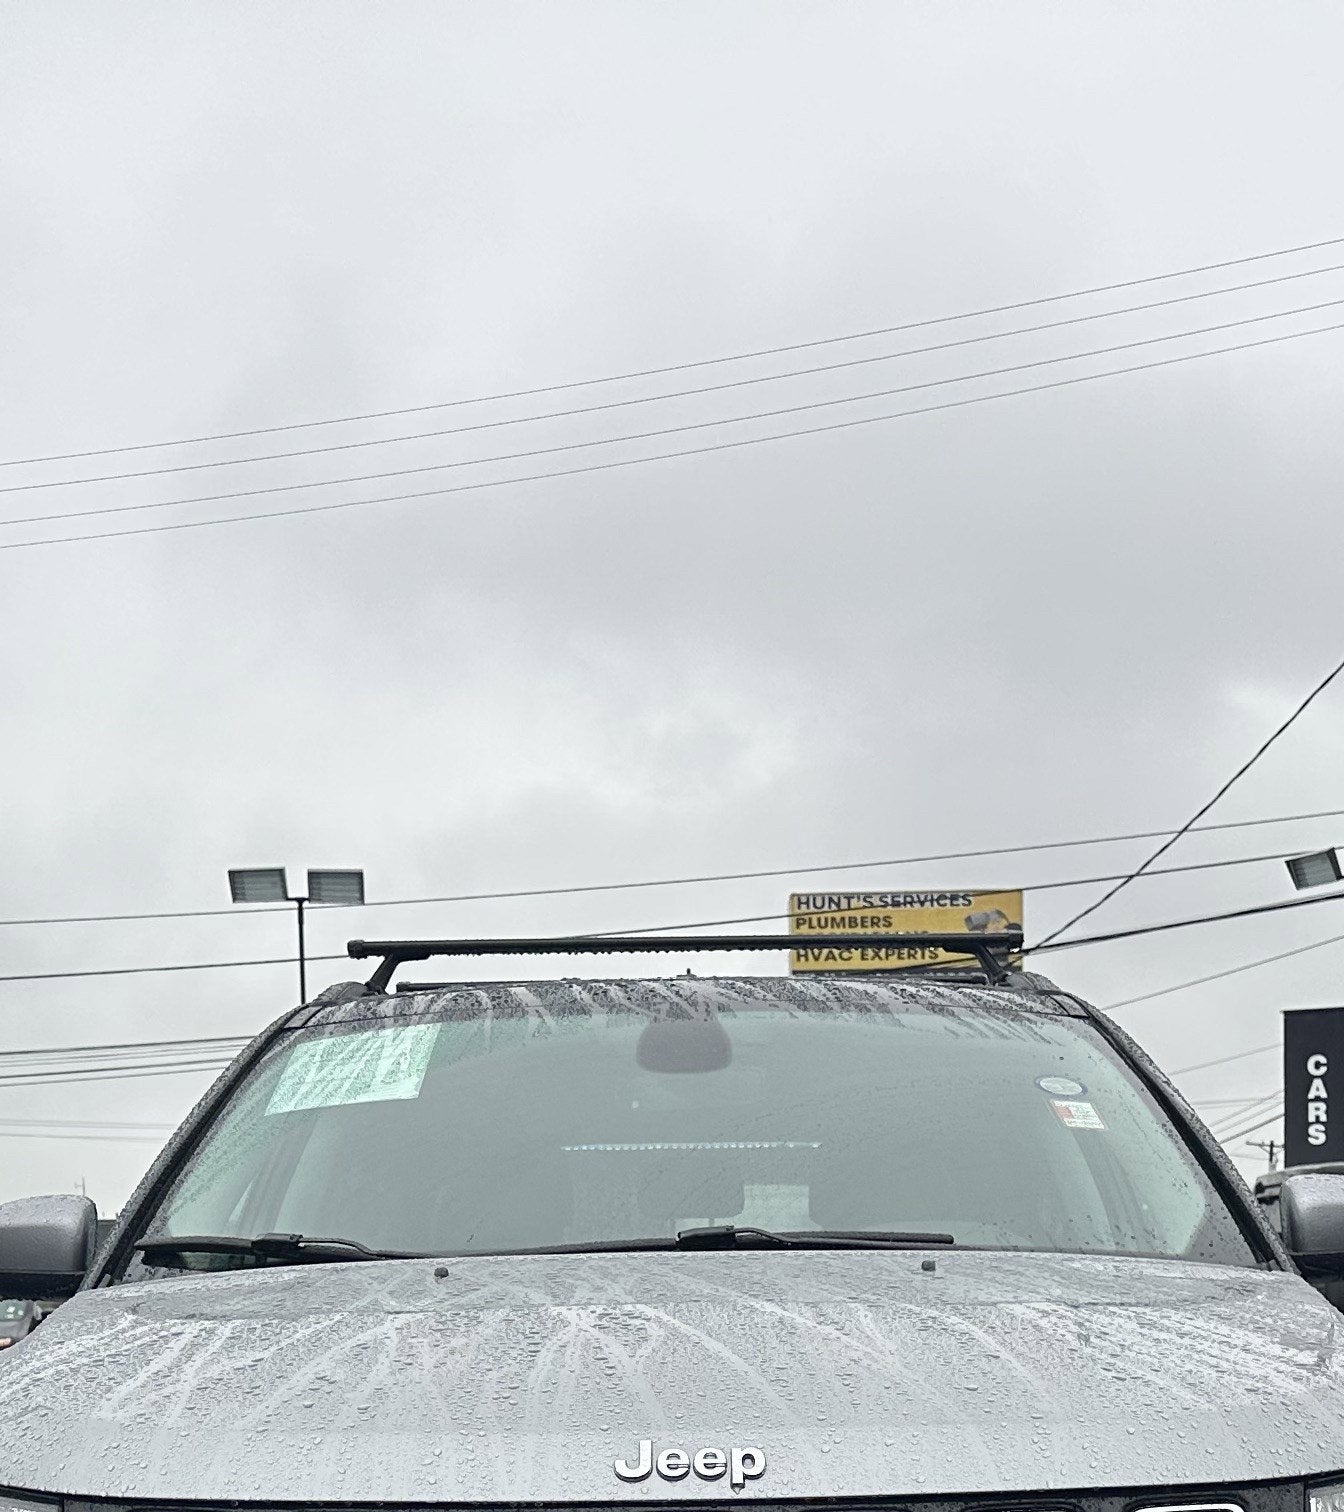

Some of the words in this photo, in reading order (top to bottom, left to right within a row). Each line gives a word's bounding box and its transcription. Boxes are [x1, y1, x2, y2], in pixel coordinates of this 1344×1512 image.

[796, 894, 874, 911] HUNT'S
[878, 893, 973, 908] SERVICES
[795, 915, 894, 930] PLUMBERS
[796, 948, 853, 962] HVAC
[860, 947, 940, 961] EXPERTS
[1306, 1053, 1328, 1146] CARS
[613, 1439, 767, 1488] Jeep
